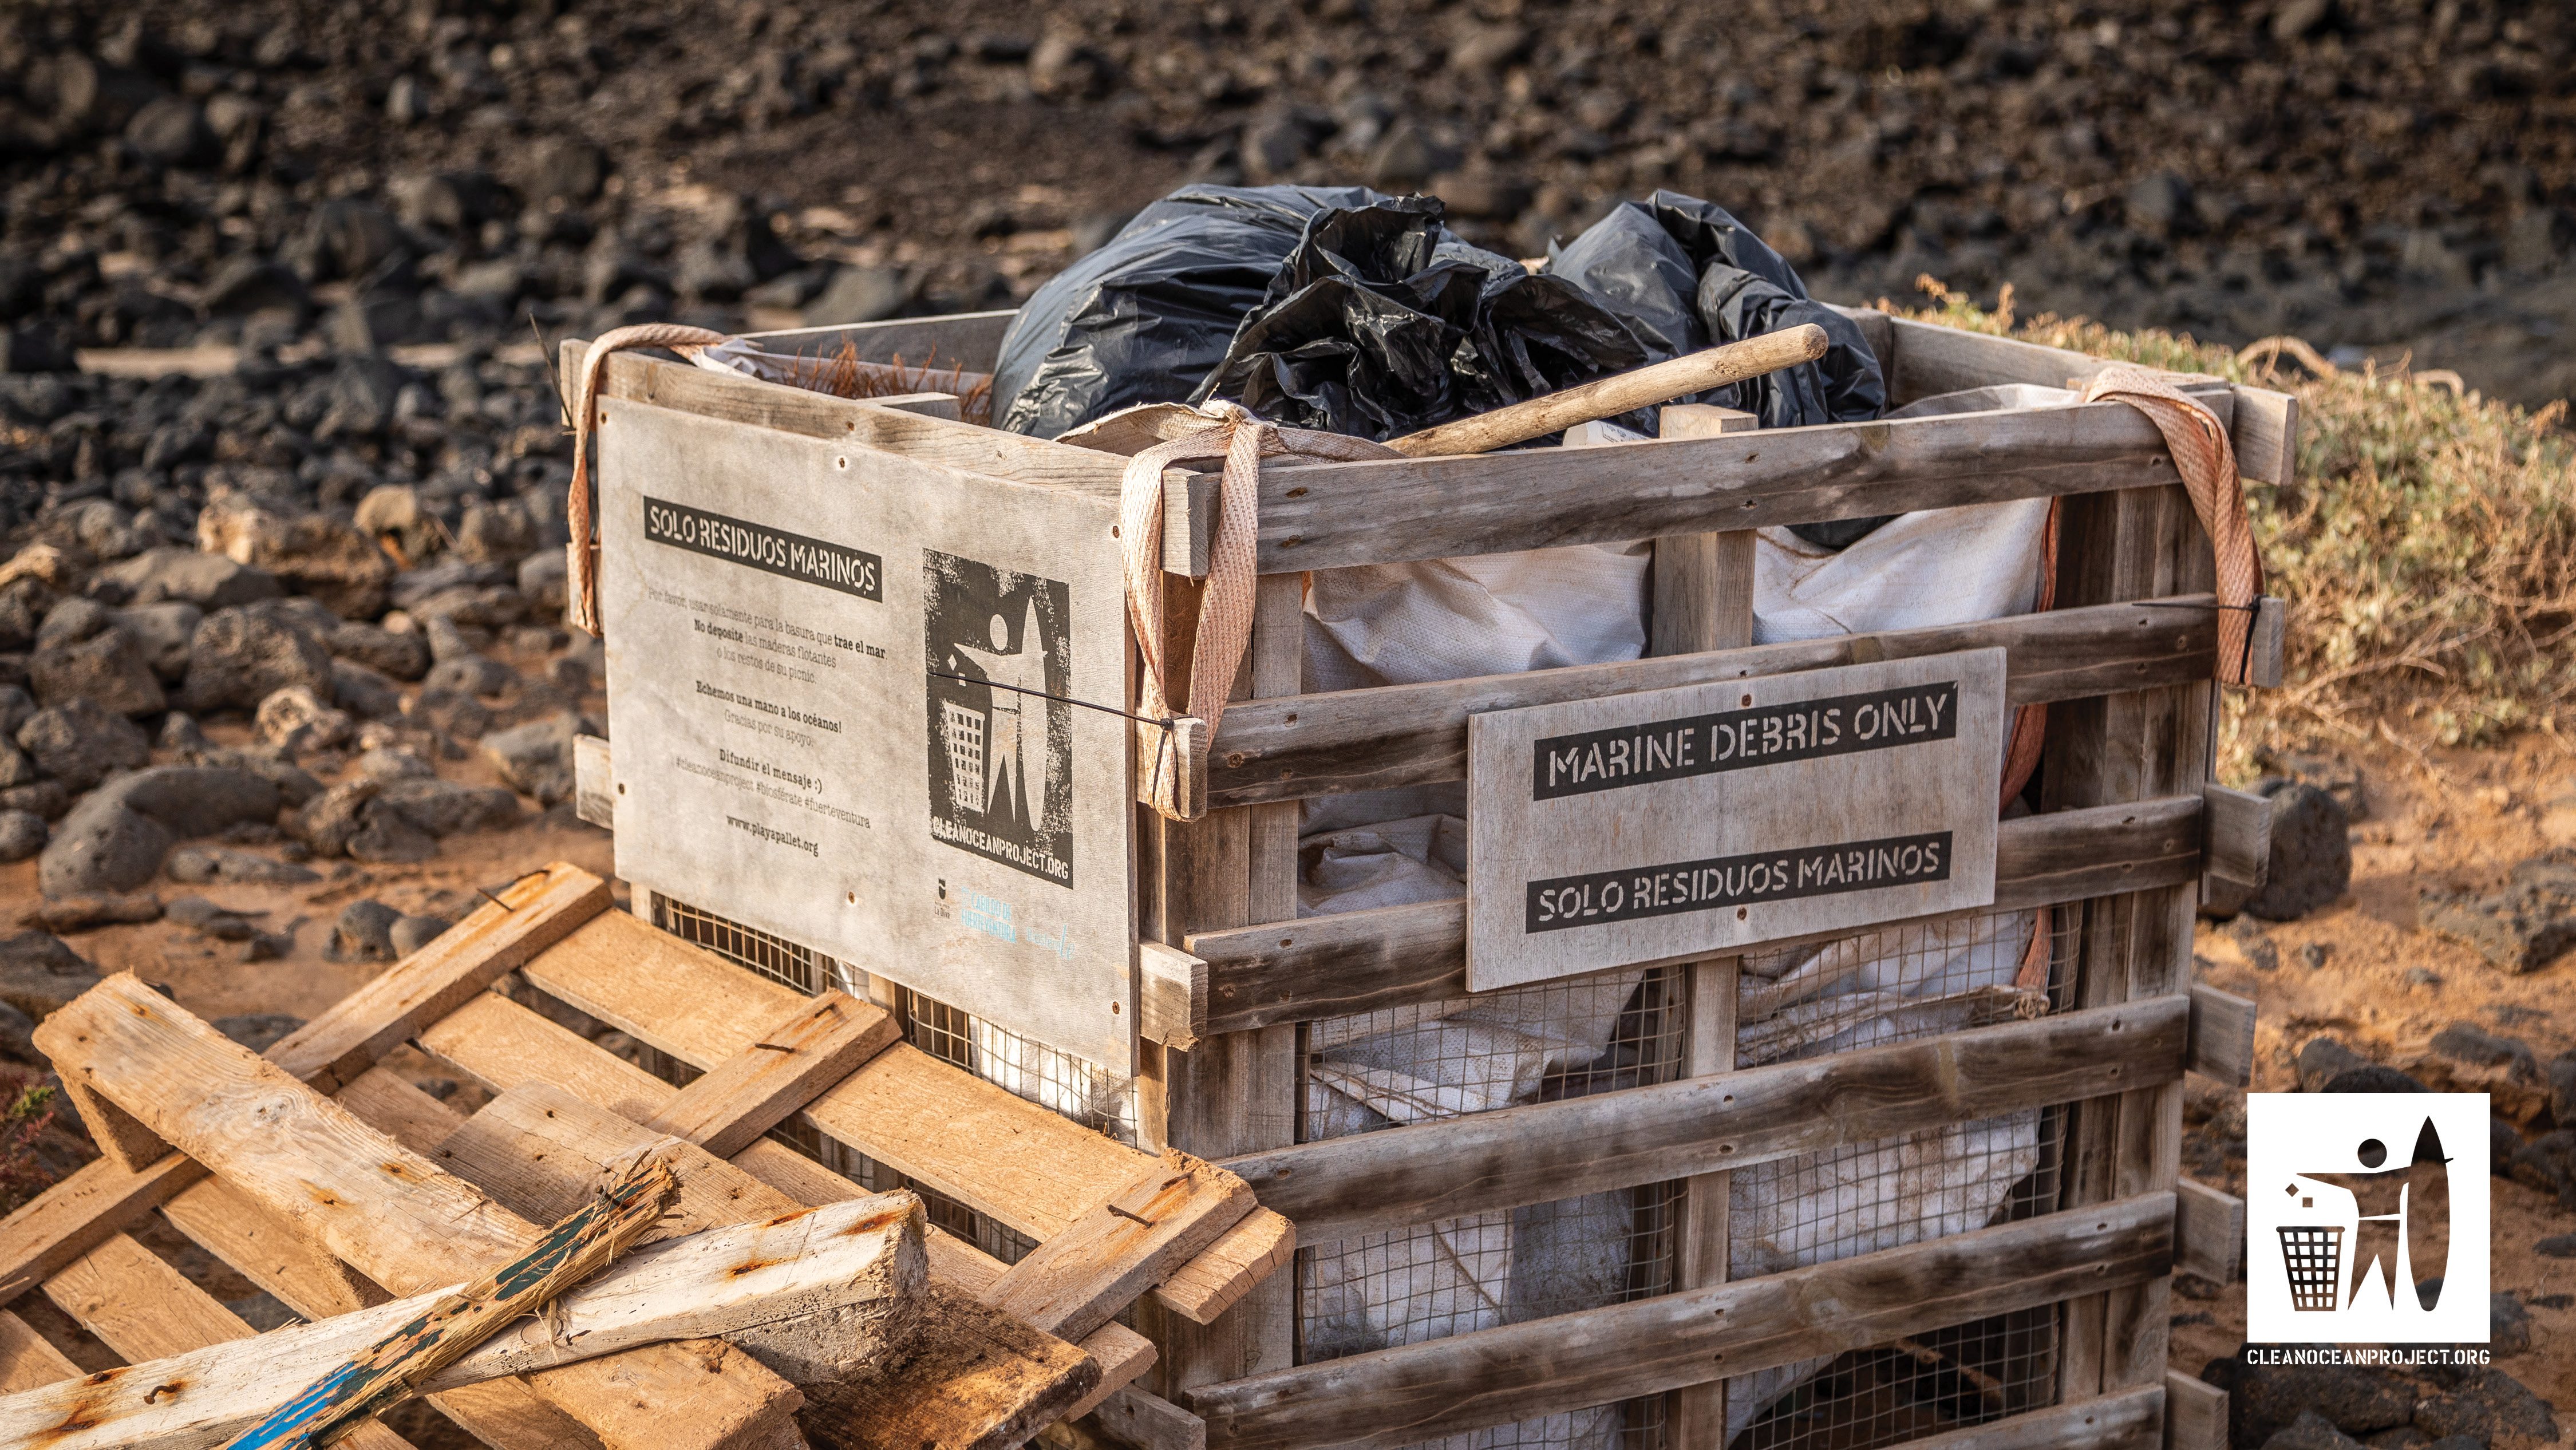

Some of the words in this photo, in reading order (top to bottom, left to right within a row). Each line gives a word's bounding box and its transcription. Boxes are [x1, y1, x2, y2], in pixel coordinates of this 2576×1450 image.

[649, 505, 696, 544] SOLO
[700, 517, 787, 568] RESIDUOS
[791, 542, 875, 592] MARINOS
[649, 586, 662, 602] Por
[689, 599, 709, 613] usar
[709, 603, 753, 625] solamente
[754, 616, 773, 629] para
[775, 618, 784, 632] la
[785, 621, 815, 642] basura
[816, 631, 832, 646] que
[834, 634, 854, 650] trae
[855, 641, 864, 654] el
[866, 645, 888, 660] mar.
[694, 618, 705, 633] No
[707, 622, 743, 643] deposite
[745, 631, 757, 647] las
[759, 638, 796, 658] maderas
[798, 645, 836, 668] flotantes
[717, 647, 722, 658] o
[724, 646, 736, 662] los
[737, 653, 763, 670] restos
[765, 658, 775, 673] de
[777, 663, 787, 676] su
[789, 665, 817, 685] picnic.
[696, 679, 734, 704] Echemos
[736, 694, 753, 708] una
[754, 700, 779, 715] mano
[781, 707, 787, 718] a
[788, 706, 801, 722] los
[803, 713, 841, 734] océanos!
[724, 709, 756, 730] Gracias
[758, 721, 773, 734] por
[774, 726, 784, 738] su
[1548, 726, 1696, 788] MARINE
[1710, 707, 1842, 763] DEBRIS
[1854, 693, 1948, 741] ONLY
[719, 749, 760, 772] Difundir
[762, 762, 771, 776] el
[773, 768, 812, 791] mensaje
[726, 815, 819, 858] www.playapallet.org
[805, 796, 871, 829] #fuerteventura
[932, 815, 1069, 880] CLEANOCEANPROJECT.ORG
[1539, 880, 1624, 922] SOLO
[1633, 858, 1789, 910] RESIDUOS
[1797, 841, 1940, 890] MARINOS
[961, 908, 1017, 943] FUERTEVENTURA
